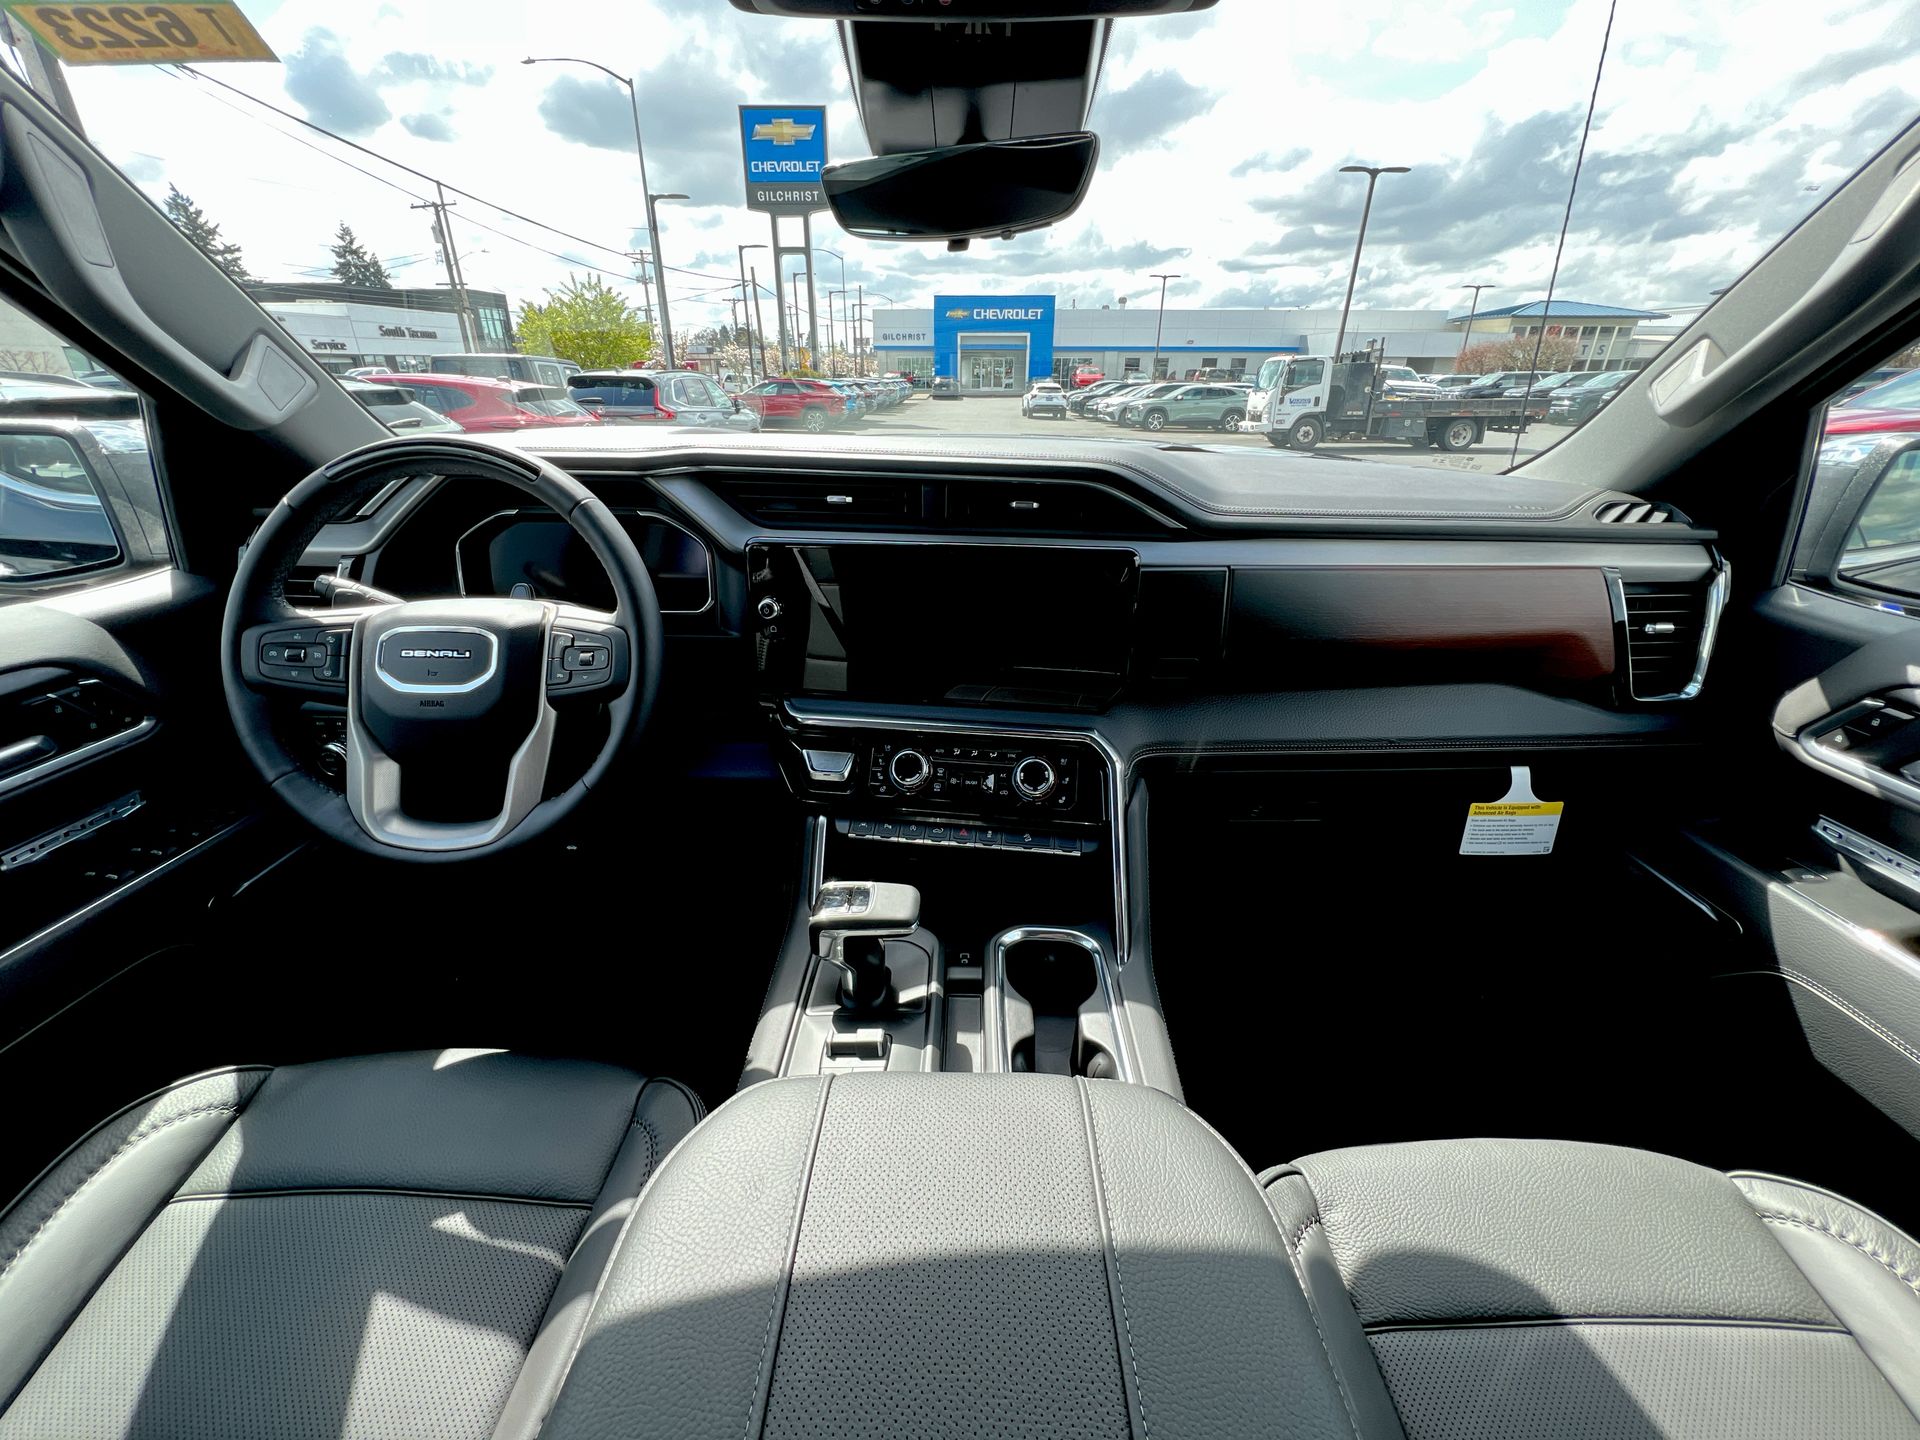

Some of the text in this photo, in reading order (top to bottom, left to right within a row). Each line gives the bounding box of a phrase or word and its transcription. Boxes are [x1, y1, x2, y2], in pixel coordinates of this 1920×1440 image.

[750, 160, 820, 173] CHEVROLET
[757, 190, 819, 202] GILCHRIST
[973, 308, 1044, 320] CHEVROLET
[378, 325, 438, 340] South Tacoma
[882, 332, 927, 341] GILCHRIST
[311, 339, 348, 351] Service
[400, 649, 471, 658] DENALI
[419, 700, 445, 708] AIRBAG
